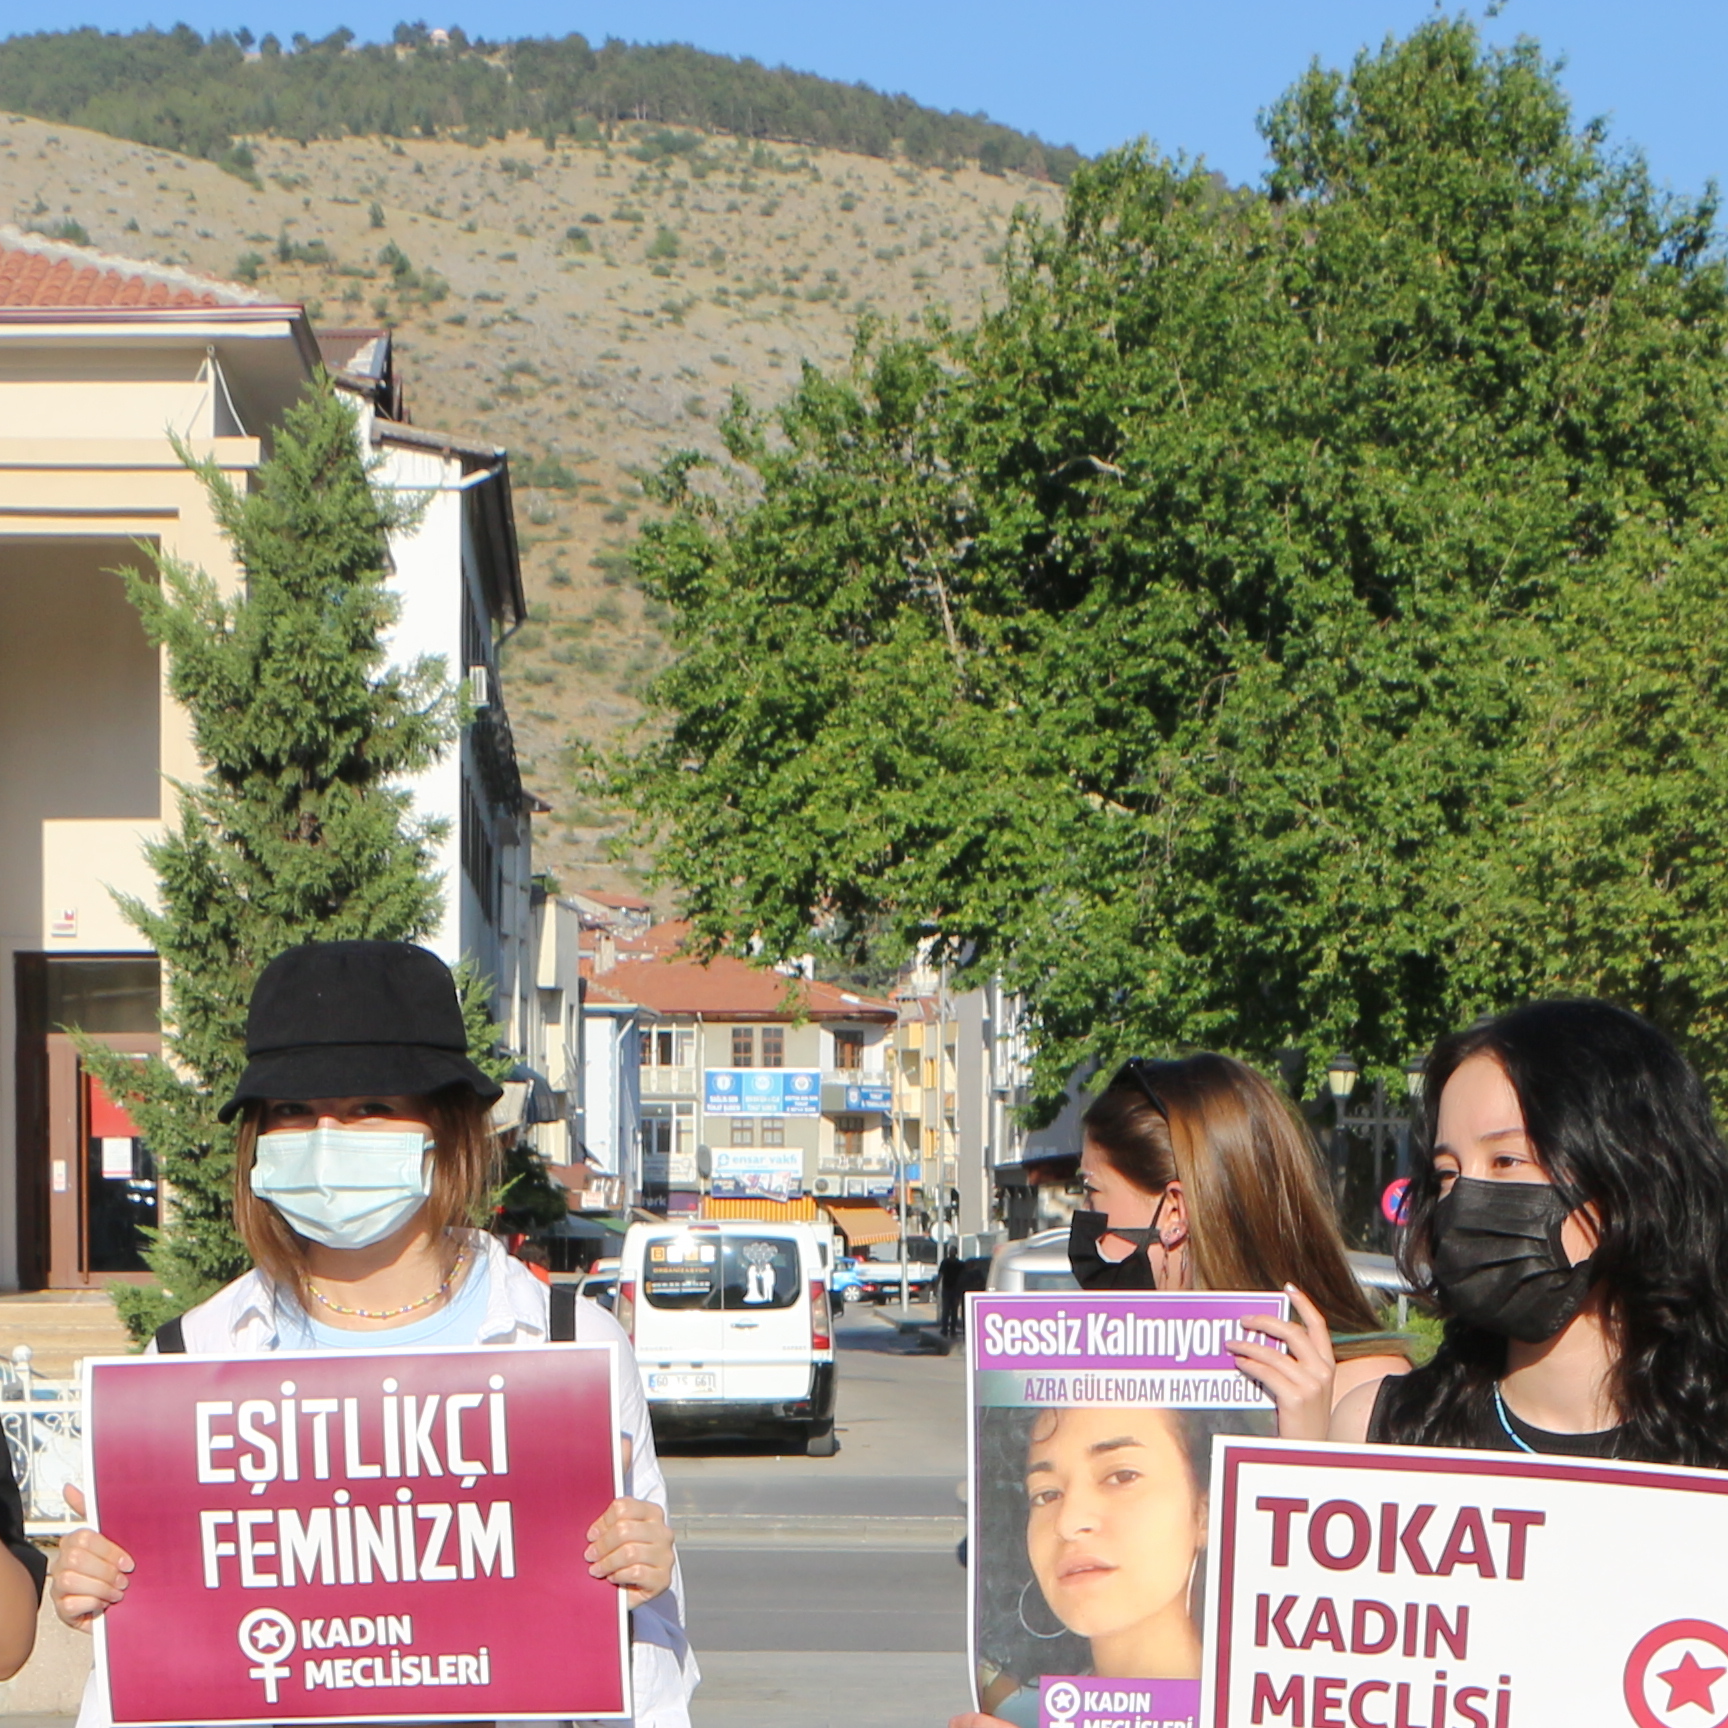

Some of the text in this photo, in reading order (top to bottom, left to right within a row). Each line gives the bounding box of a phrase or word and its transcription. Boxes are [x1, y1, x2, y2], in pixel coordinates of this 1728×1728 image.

[984, 1310, 1081, 1357] Sessiz
[1023, 1377, 1069, 1403] AZRA
[1071, 1372, 1166, 1403] GÜLENDAM
[194, 1373, 510, 1496] EŞİTLİKÇİ
[199, 1487, 517, 1590] FEMİNİZM
[1255, 1496, 1547, 1581] TOKAT
[301, 1614, 414, 1649] KADIN
[1253, 1592, 1470, 1661] KADIN
[303, 1646, 492, 1691] MECLİSLERİ
[1083, 1690, 1151, 1714] KADIN
